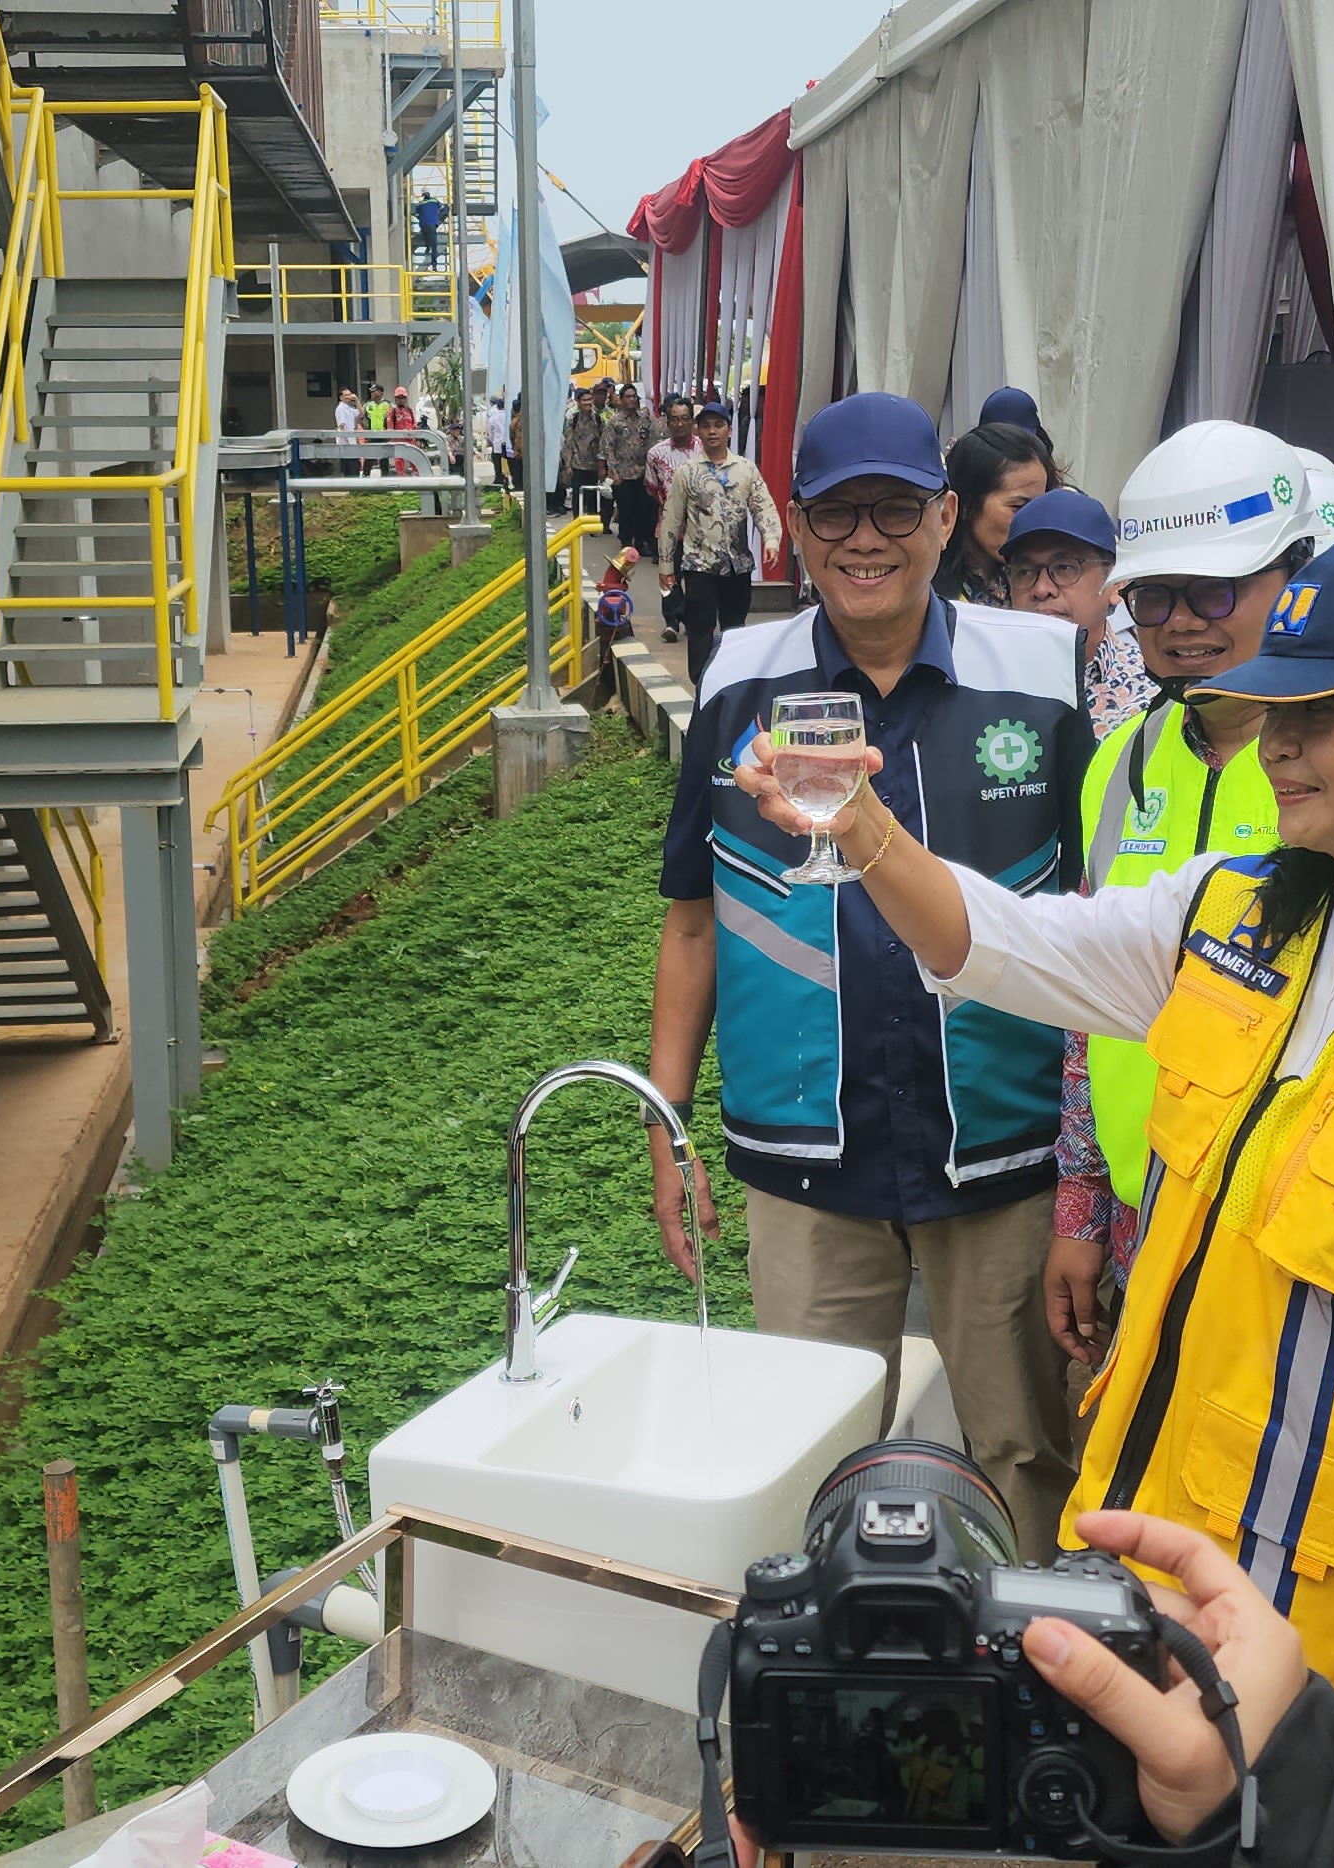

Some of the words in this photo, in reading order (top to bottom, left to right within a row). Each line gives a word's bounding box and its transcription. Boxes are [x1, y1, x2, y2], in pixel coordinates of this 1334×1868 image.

[1139, 511, 1217, 535] JATILUHUR
[980, 786, 1017, 801] SAFETY
[1019, 782, 1047, 797] FIRST
[1200, 939, 1255, 979] WAMEN
[1251, 968, 1276, 988] PU
